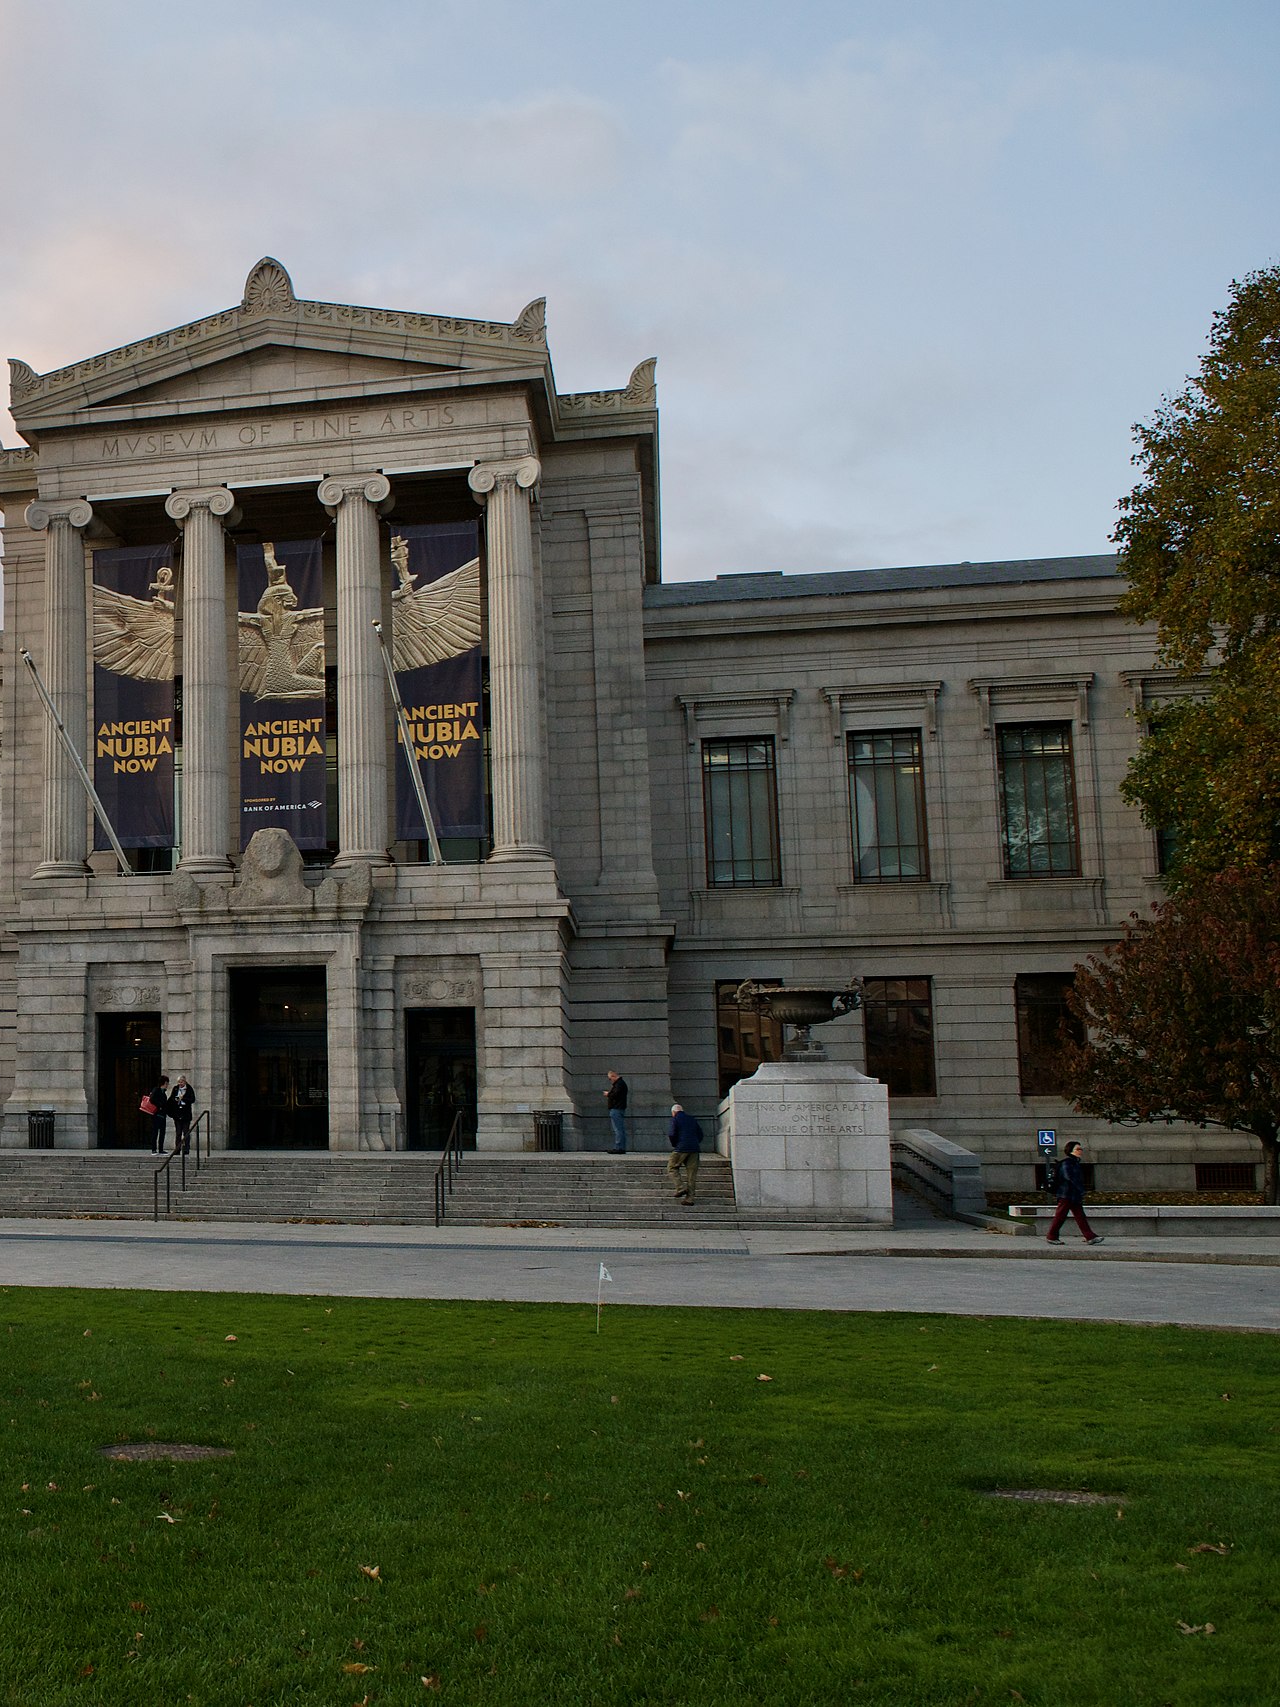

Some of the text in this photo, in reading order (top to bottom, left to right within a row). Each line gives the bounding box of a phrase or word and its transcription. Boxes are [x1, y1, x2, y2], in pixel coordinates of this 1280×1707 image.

[101, 406, 455, 458] MVSEVM OF FINE ARTS
[98, 718, 172, 736] ANCIENT
[244, 718, 323, 736] ANCIENT
[97, 735, 173, 758] NUBIA
[243, 735, 324, 758] NUBIA
[415, 743, 462, 760] NOW
[113, 758, 158, 774] NOW
[260, 758, 306, 774] NOW
[748, 1104, 775, 1112] BANK
[779, 1104, 791, 1112] OF
[796, 1104, 839, 1112] AMERICA
